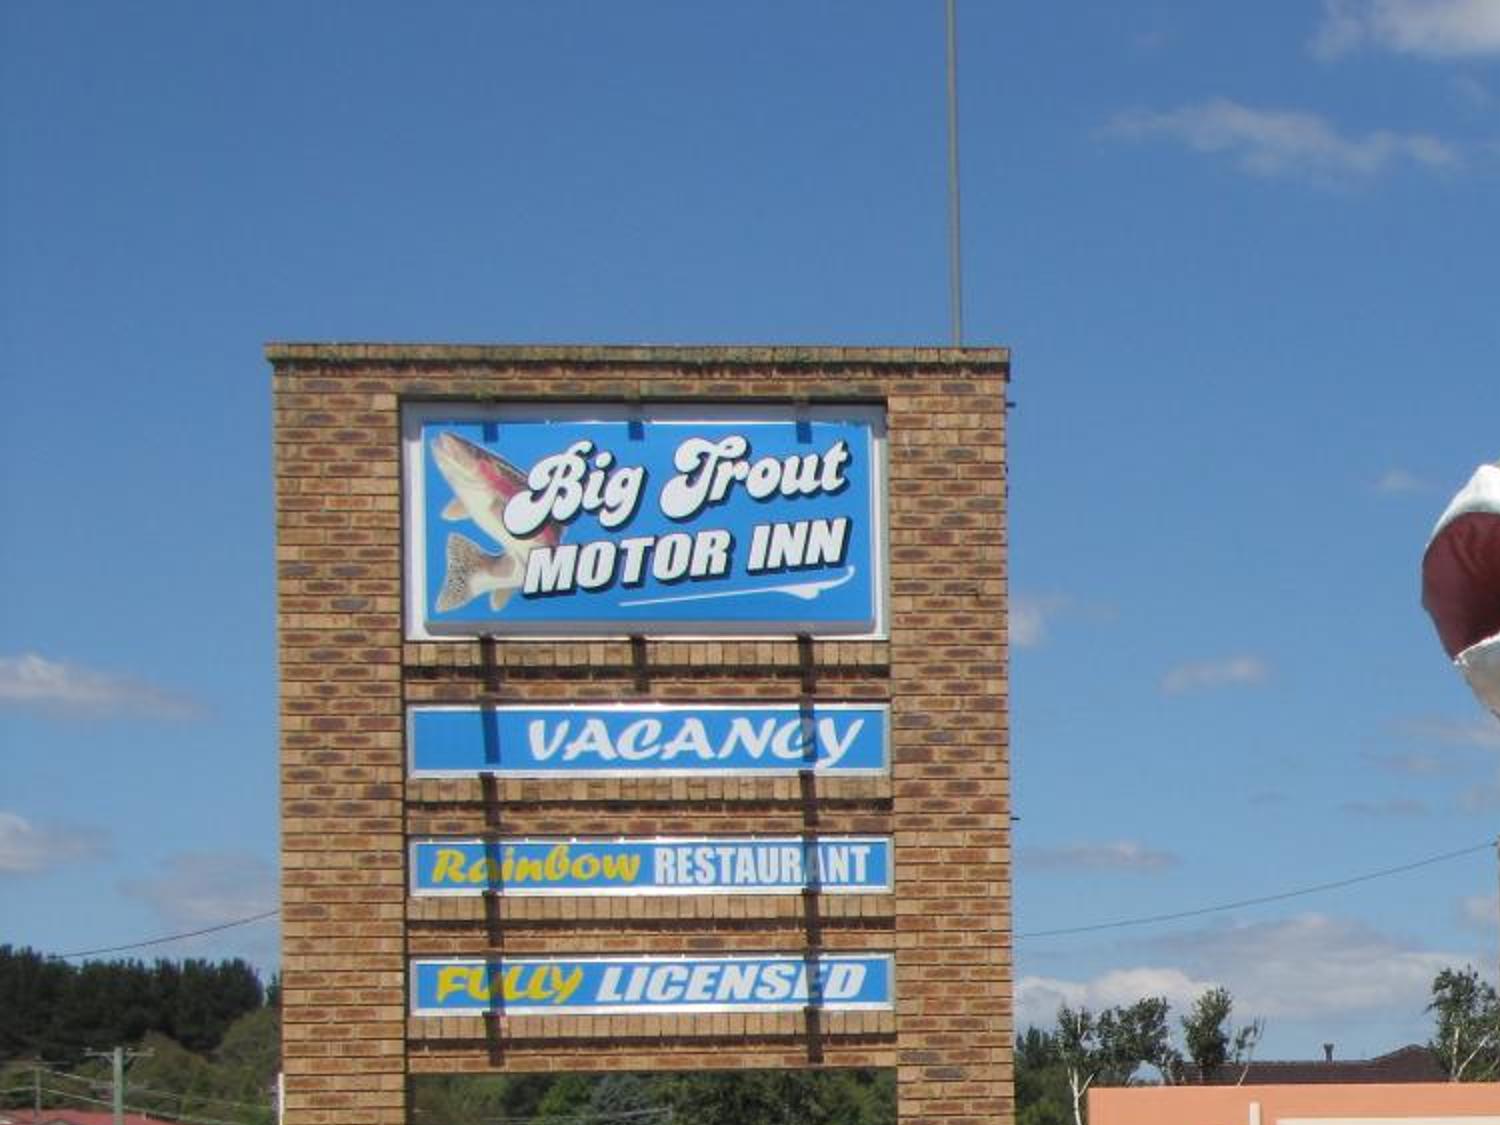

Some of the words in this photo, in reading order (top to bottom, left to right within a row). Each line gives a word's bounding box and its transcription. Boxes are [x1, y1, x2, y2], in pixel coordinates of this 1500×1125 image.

[503, 440, 646, 535] Big
[660, 435, 850, 519] Trout
[523, 528, 733, 597] MOTOR
[746, 516, 850, 575] INN
[528, 717, 864, 768] VACANCY
[431, 844, 641, 883] Rainbow
[654, 845, 870, 886] RESTAURANT
[436, 964, 584, 1003] FULLY
[596, 962, 867, 1003] LICENSED
